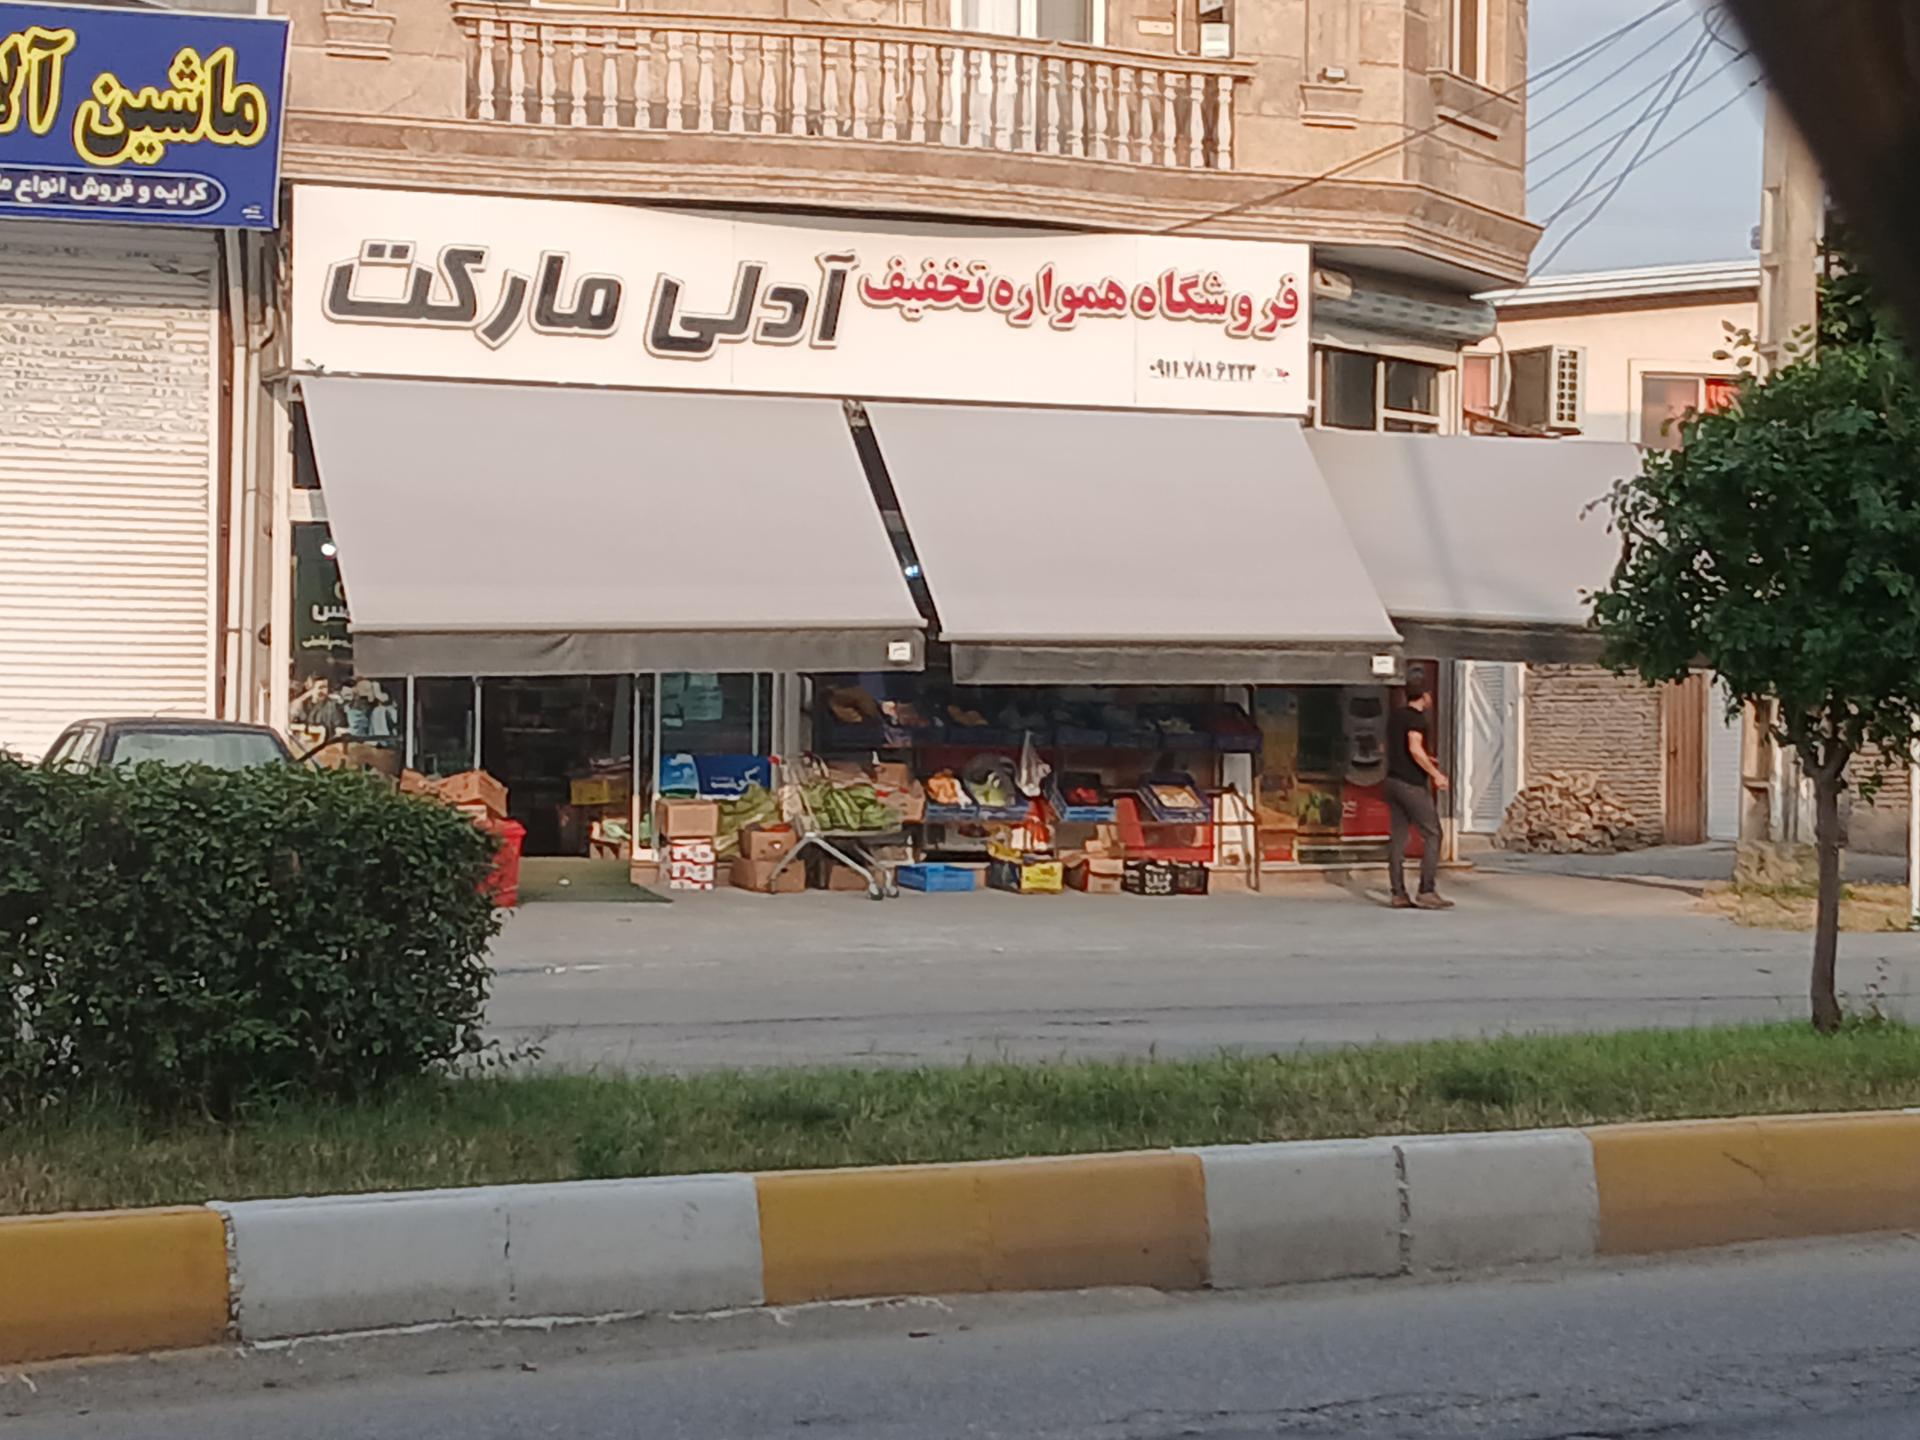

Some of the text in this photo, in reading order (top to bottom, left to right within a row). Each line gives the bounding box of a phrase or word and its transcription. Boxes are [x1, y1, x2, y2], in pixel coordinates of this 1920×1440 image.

[72, 47, 267, 166] ماشین
[15, 175, 67, 203] انواع
[70, 176, 134, 202] فروش
[137, 184, 151, 203] و
[154, 181, 209, 206] کرایه
[321, 238, 1300, 360] فروشگاه همواره تخفیف آدلی مارکت
